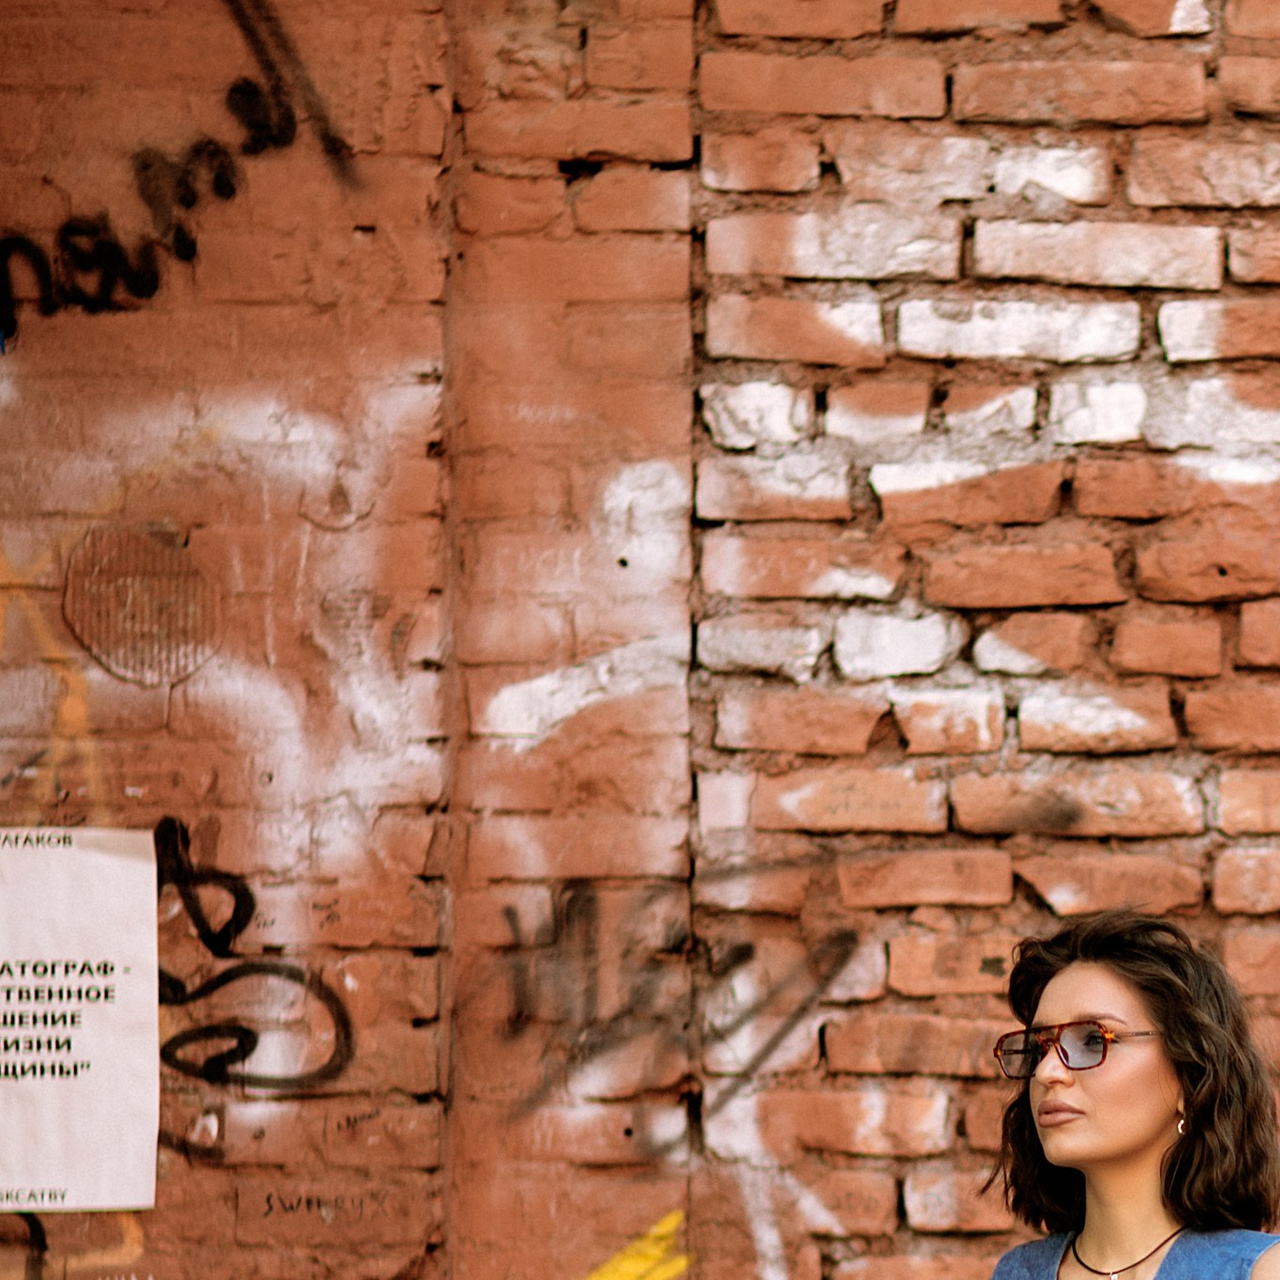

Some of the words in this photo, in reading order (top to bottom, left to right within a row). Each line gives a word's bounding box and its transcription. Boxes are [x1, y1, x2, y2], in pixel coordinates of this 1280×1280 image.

[0, 833, 73, 849] ЛГАКОВ
[0, 960, 115, 979] АТОГРАФ
[0, 985, 116, 1004] ТВЕННОЕ
[0, 1036, 72, 1054] ИЗНИ
